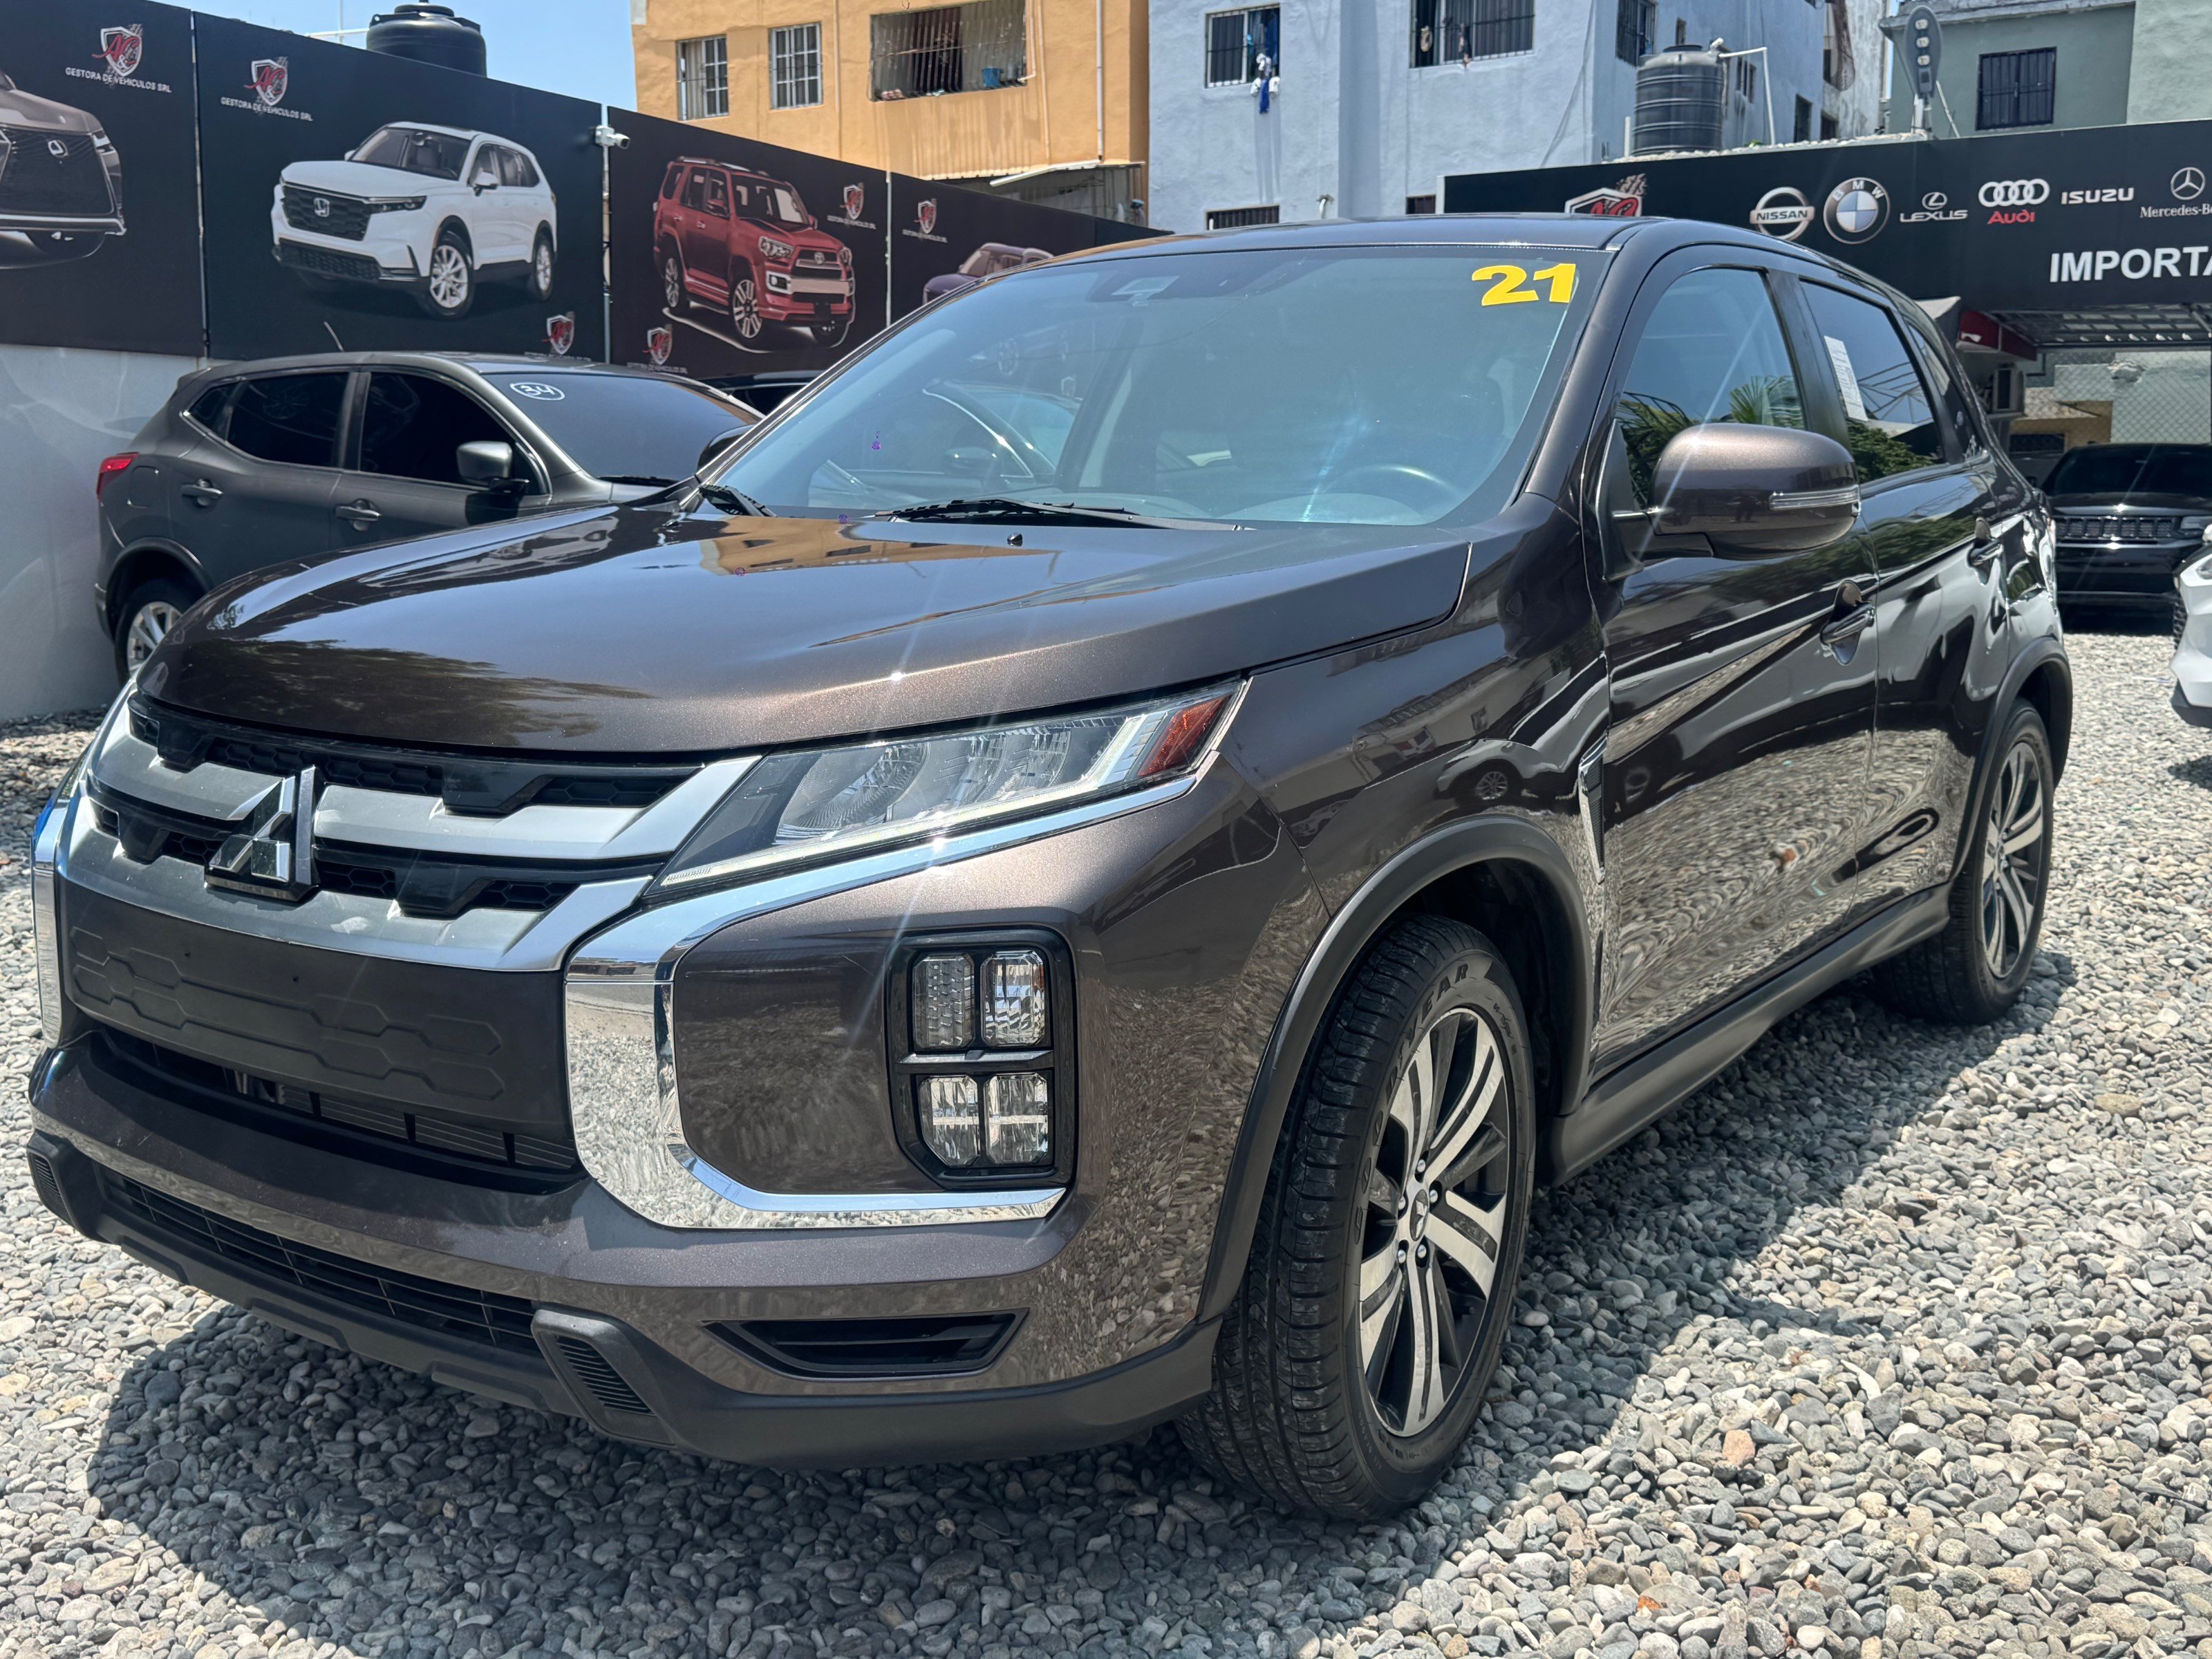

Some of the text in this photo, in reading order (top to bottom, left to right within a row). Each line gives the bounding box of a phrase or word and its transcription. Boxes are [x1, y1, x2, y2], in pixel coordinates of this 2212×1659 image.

[65, 67, 101, 81] GESTORA
[102, 74, 113, 83] DE
[158, 83, 171, 93] SRL
[1832, 180, 1884, 201] BMW
[2061, 187, 2135, 205] ISUZU
[1756, 209, 1808, 221] NISSAN
[1900, 209, 1969, 223] LEXUS
[1987, 209, 2036, 225] Audi
[1472, 263, 1576, 306] 21
[520, 385, 555, 396] 34
